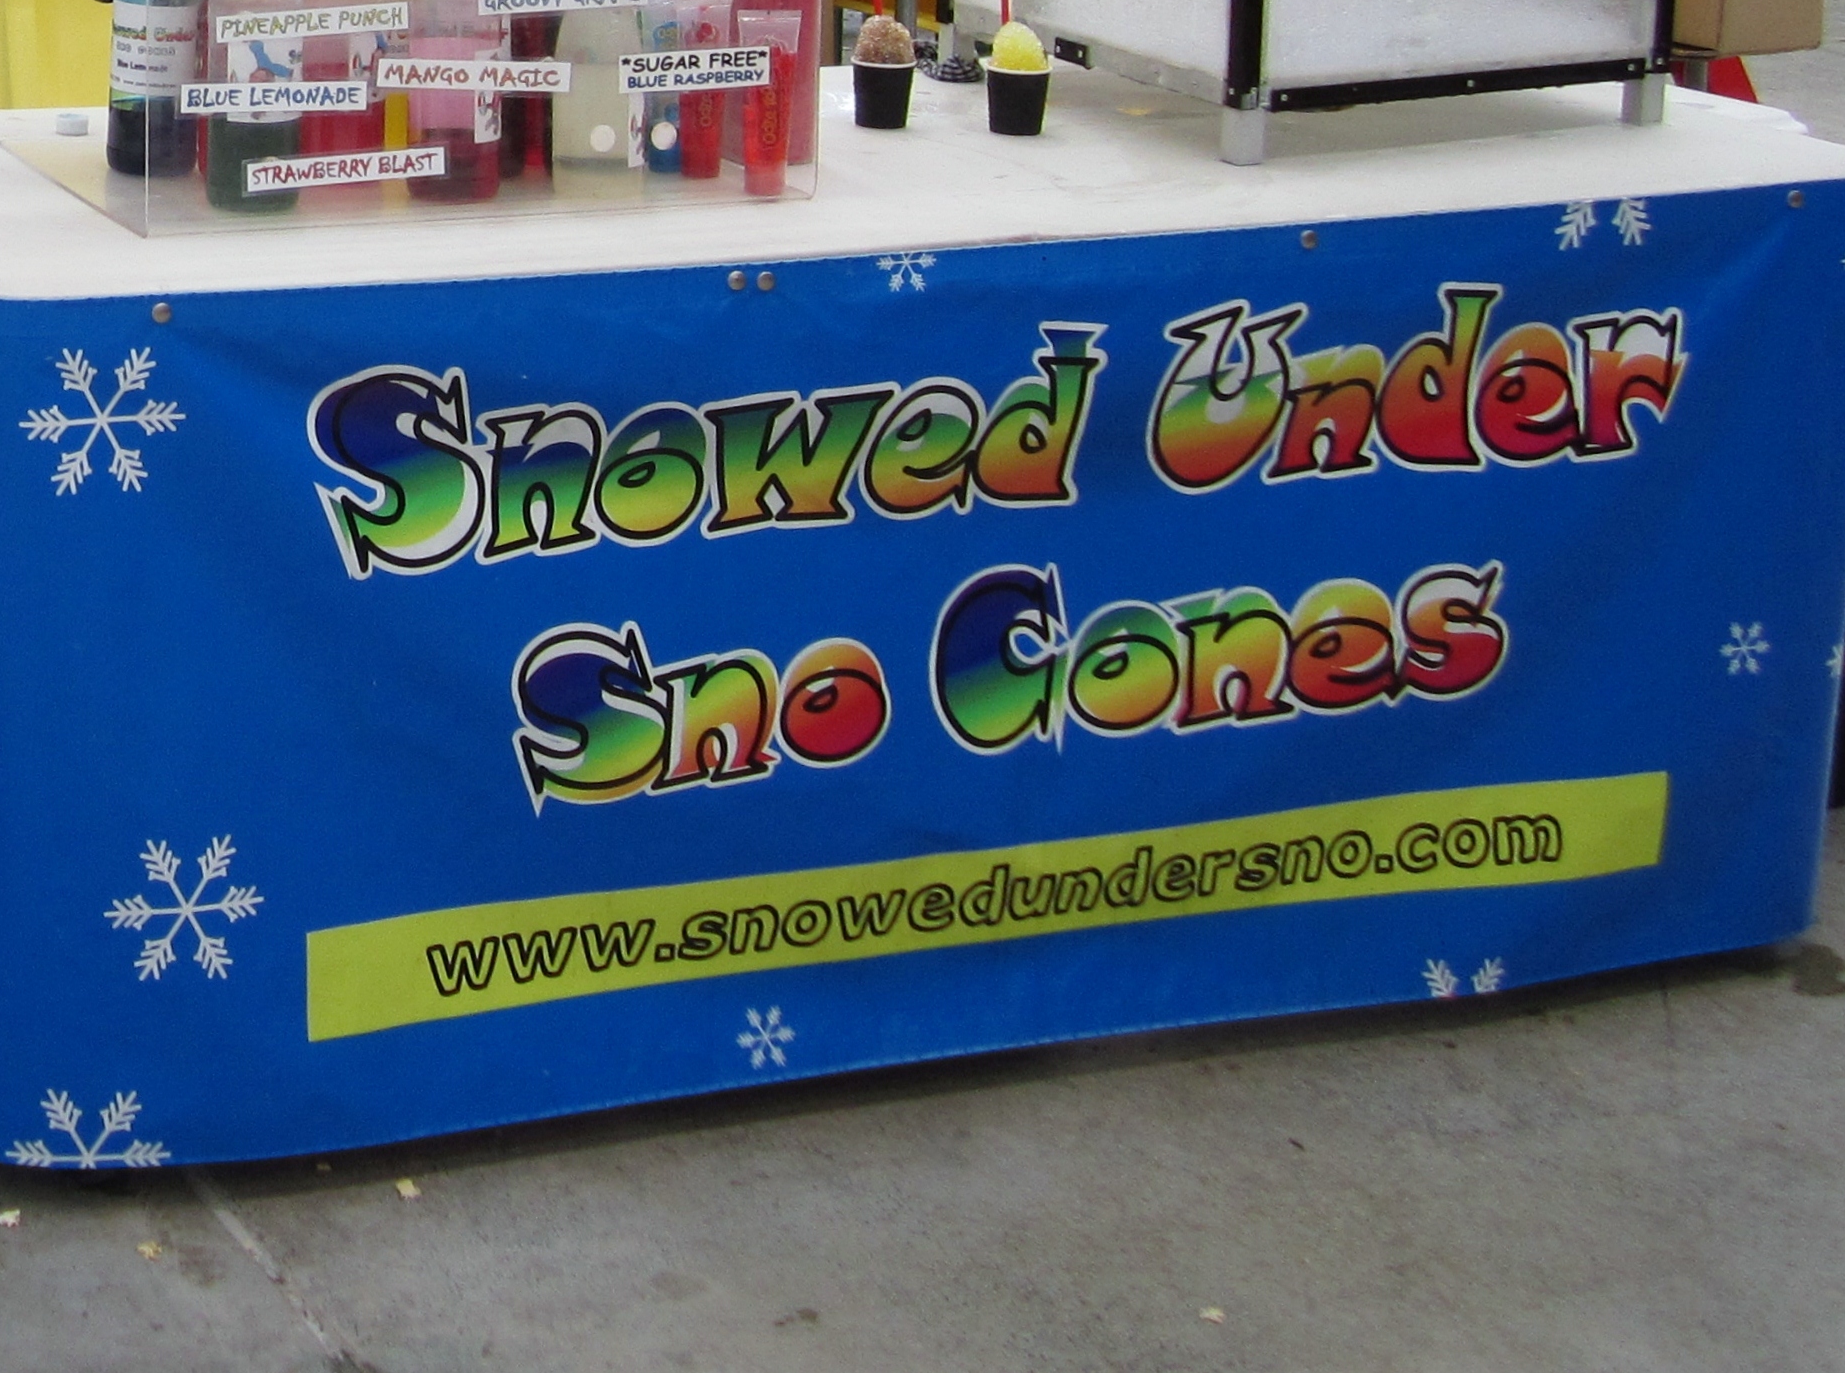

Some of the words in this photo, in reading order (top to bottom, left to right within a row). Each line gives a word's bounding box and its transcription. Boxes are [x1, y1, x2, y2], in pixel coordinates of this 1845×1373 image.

[220, 12, 331, 38] PINEAPPLE
[337, 6, 405, 29] PUNCH
[384, 64, 471, 86] MANGO
[478, 66, 562, 88] MAGIC
[627, 74, 668, 89] BLUE
[673, 69, 765, 86] RASPBERRY
[186, 87, 244, 108] BLUE
[248, 85, 363, 108] LEMONADE
[252, 157, 374, 187] STRAWBERRY
[377, 151, 441, 175] BLAST
[307, 320, 1110, 581] Snowed
[1147, 281, 1689, 496] Under
[513, 622, 894, 819] Sno
[928, 558, 1510, 756] Cones
[426, 805, 1565, 999] www.snowedundersno.com
